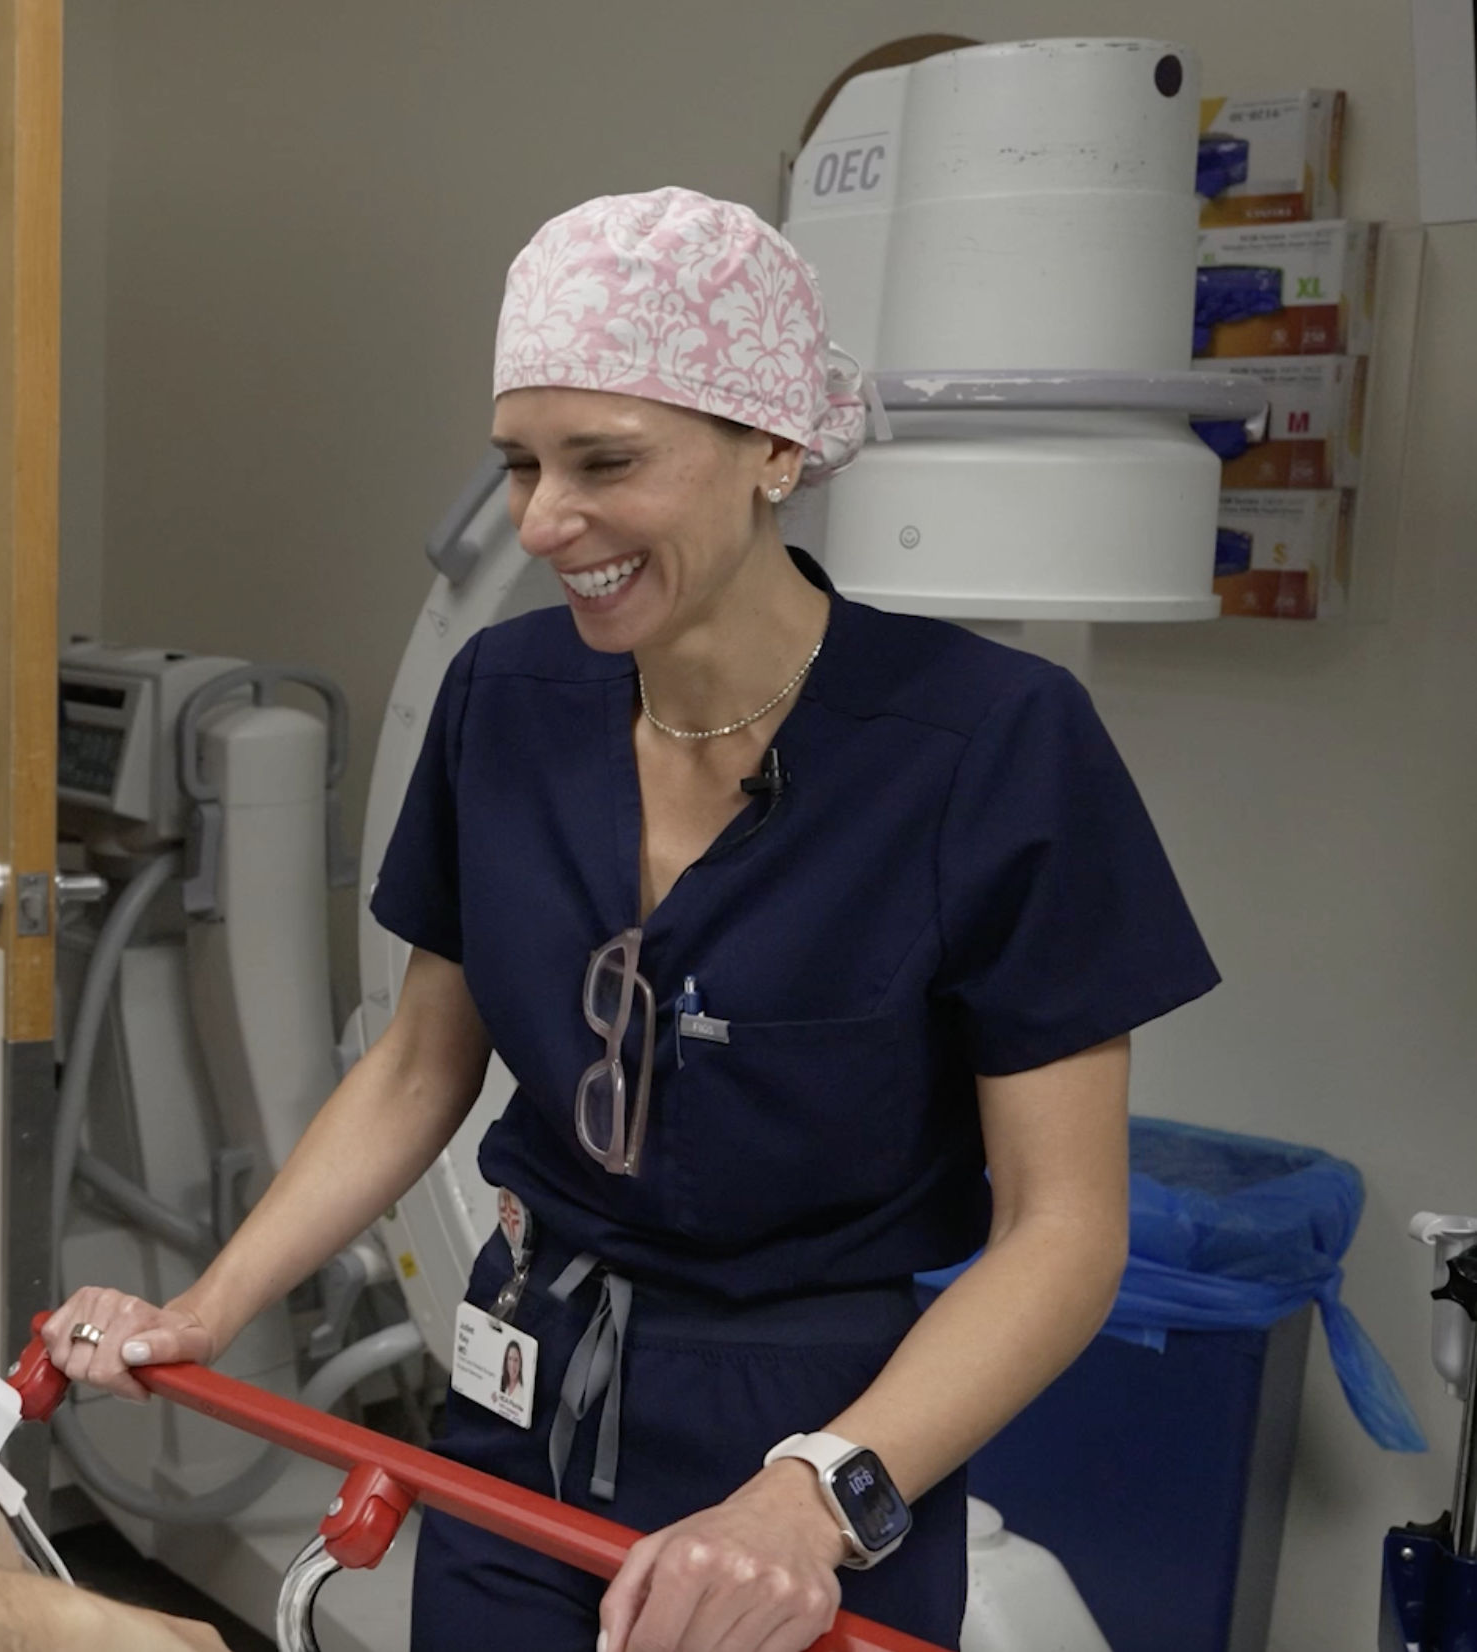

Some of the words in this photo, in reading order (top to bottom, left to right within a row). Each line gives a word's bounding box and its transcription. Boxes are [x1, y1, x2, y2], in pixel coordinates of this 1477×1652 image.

[813, 145, 885, 197] OEC
[1296, 277, 1324, 299] XL
[1288, 411, 1310, 434] M
[1274, 543, 1288, 565] S
[693, 1021, 714, 1035] FIGS
